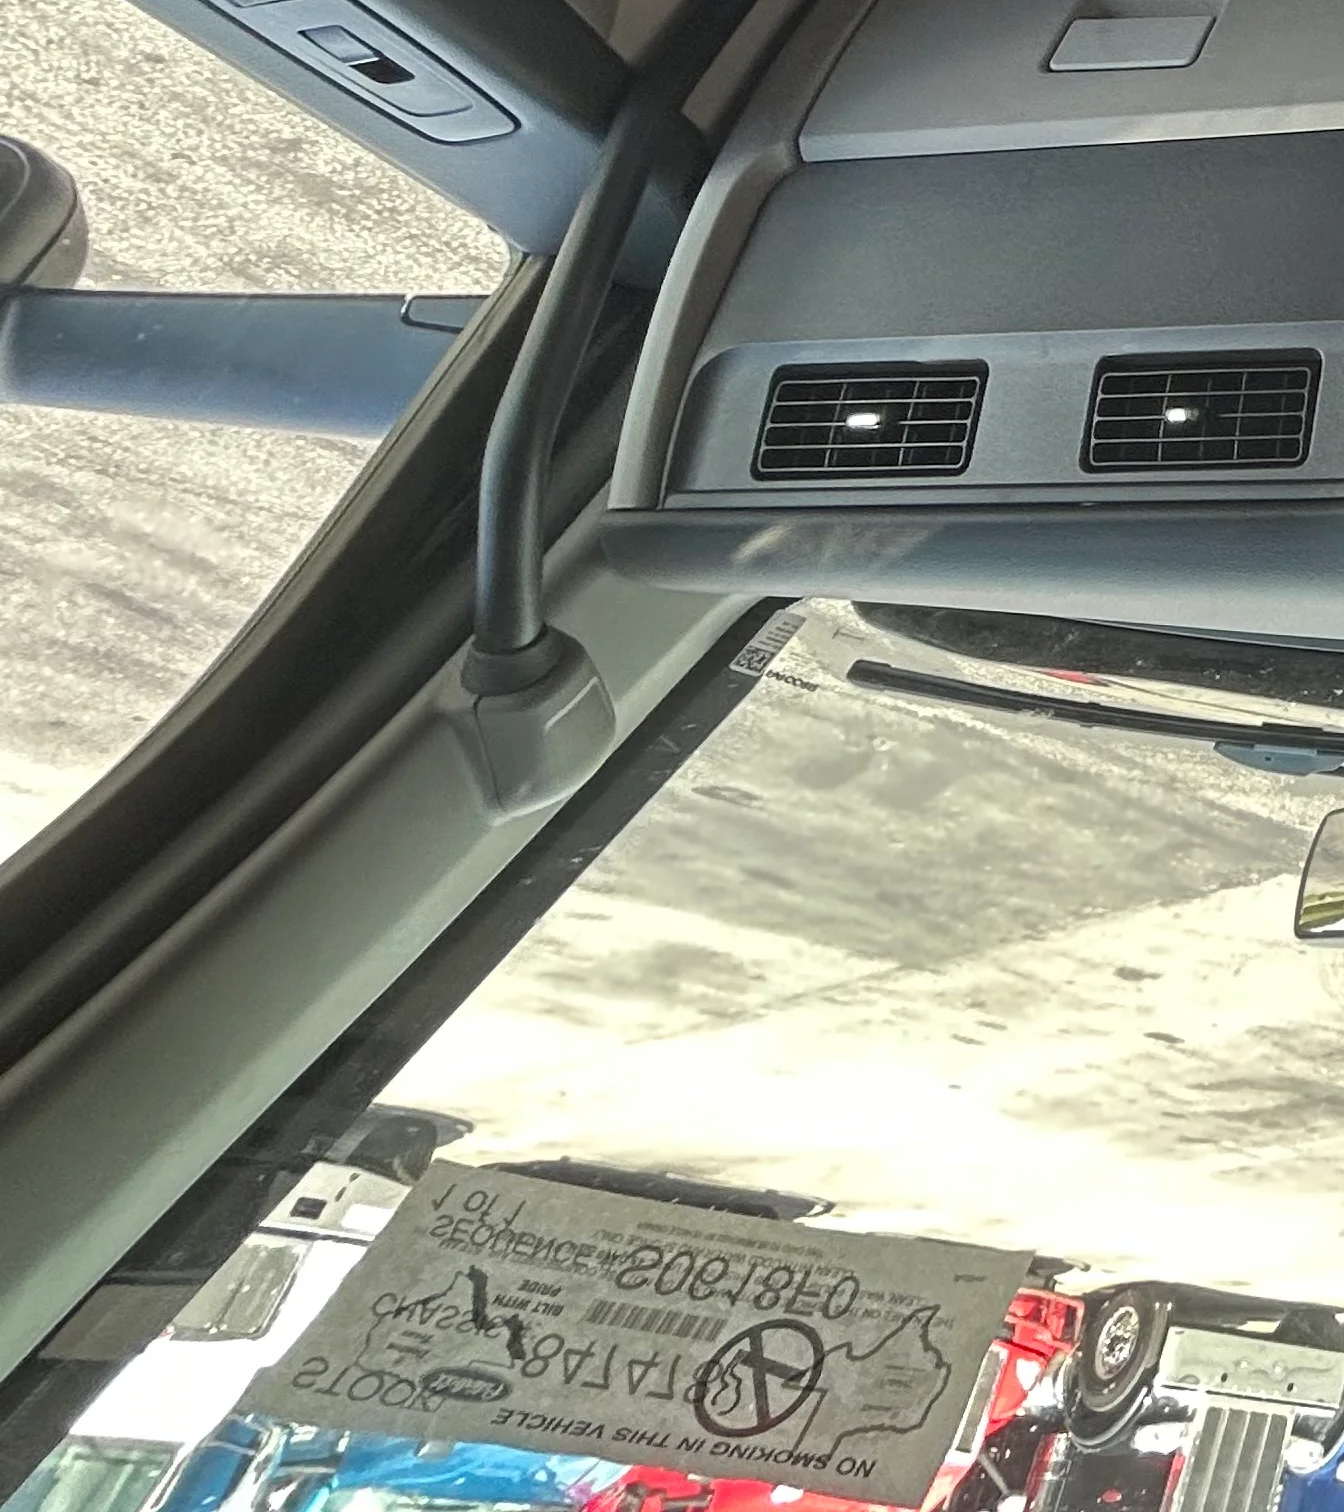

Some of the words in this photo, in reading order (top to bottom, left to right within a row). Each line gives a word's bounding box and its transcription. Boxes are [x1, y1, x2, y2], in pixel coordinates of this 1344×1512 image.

[516, 1280, 562, 1299] PRIDE
[490, 1408, 607, 1440] VEHICLE
[611, 1427, 672, 1449] THIS
[676, 1435, 706, 1454] IN
[710, 1441, 832, 1470] SMOKING
[836, 1456, 876, 1479] NO
